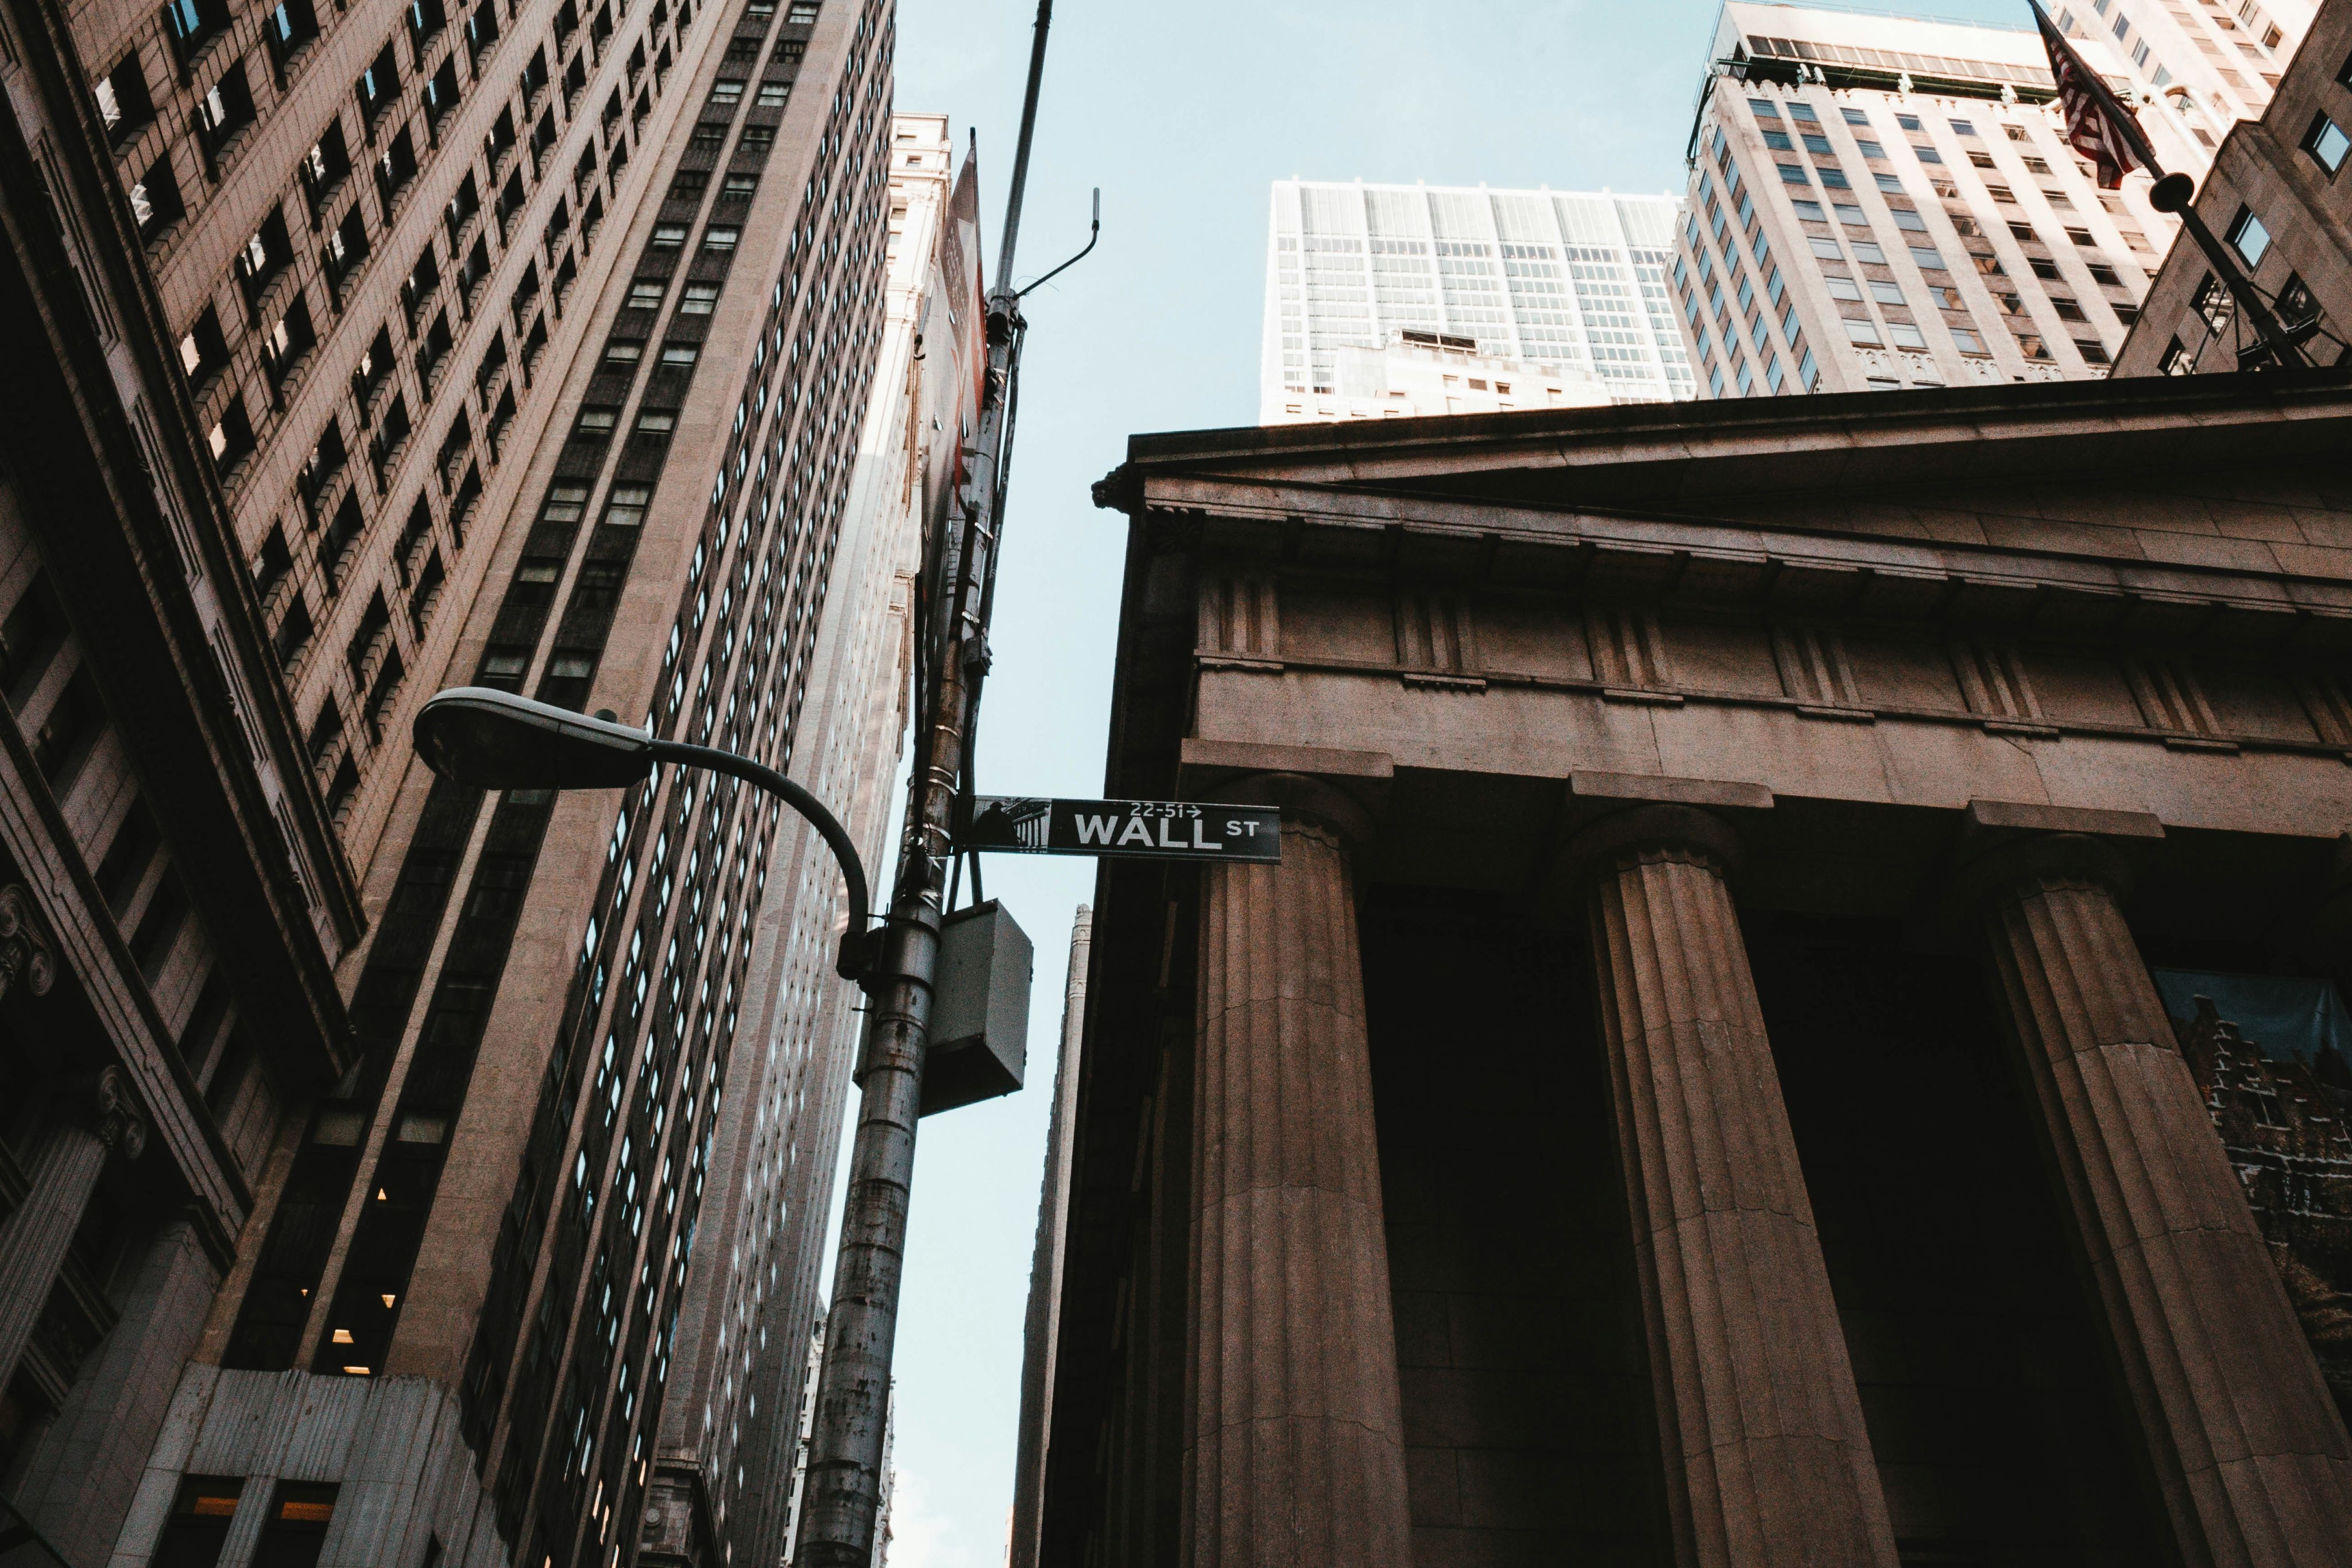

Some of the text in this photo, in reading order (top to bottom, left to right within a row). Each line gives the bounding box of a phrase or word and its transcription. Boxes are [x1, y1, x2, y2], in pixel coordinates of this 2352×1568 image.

[1130, 802, 1183, 818] 22-51
[1074, 814, 1260, 850] WALL ST
